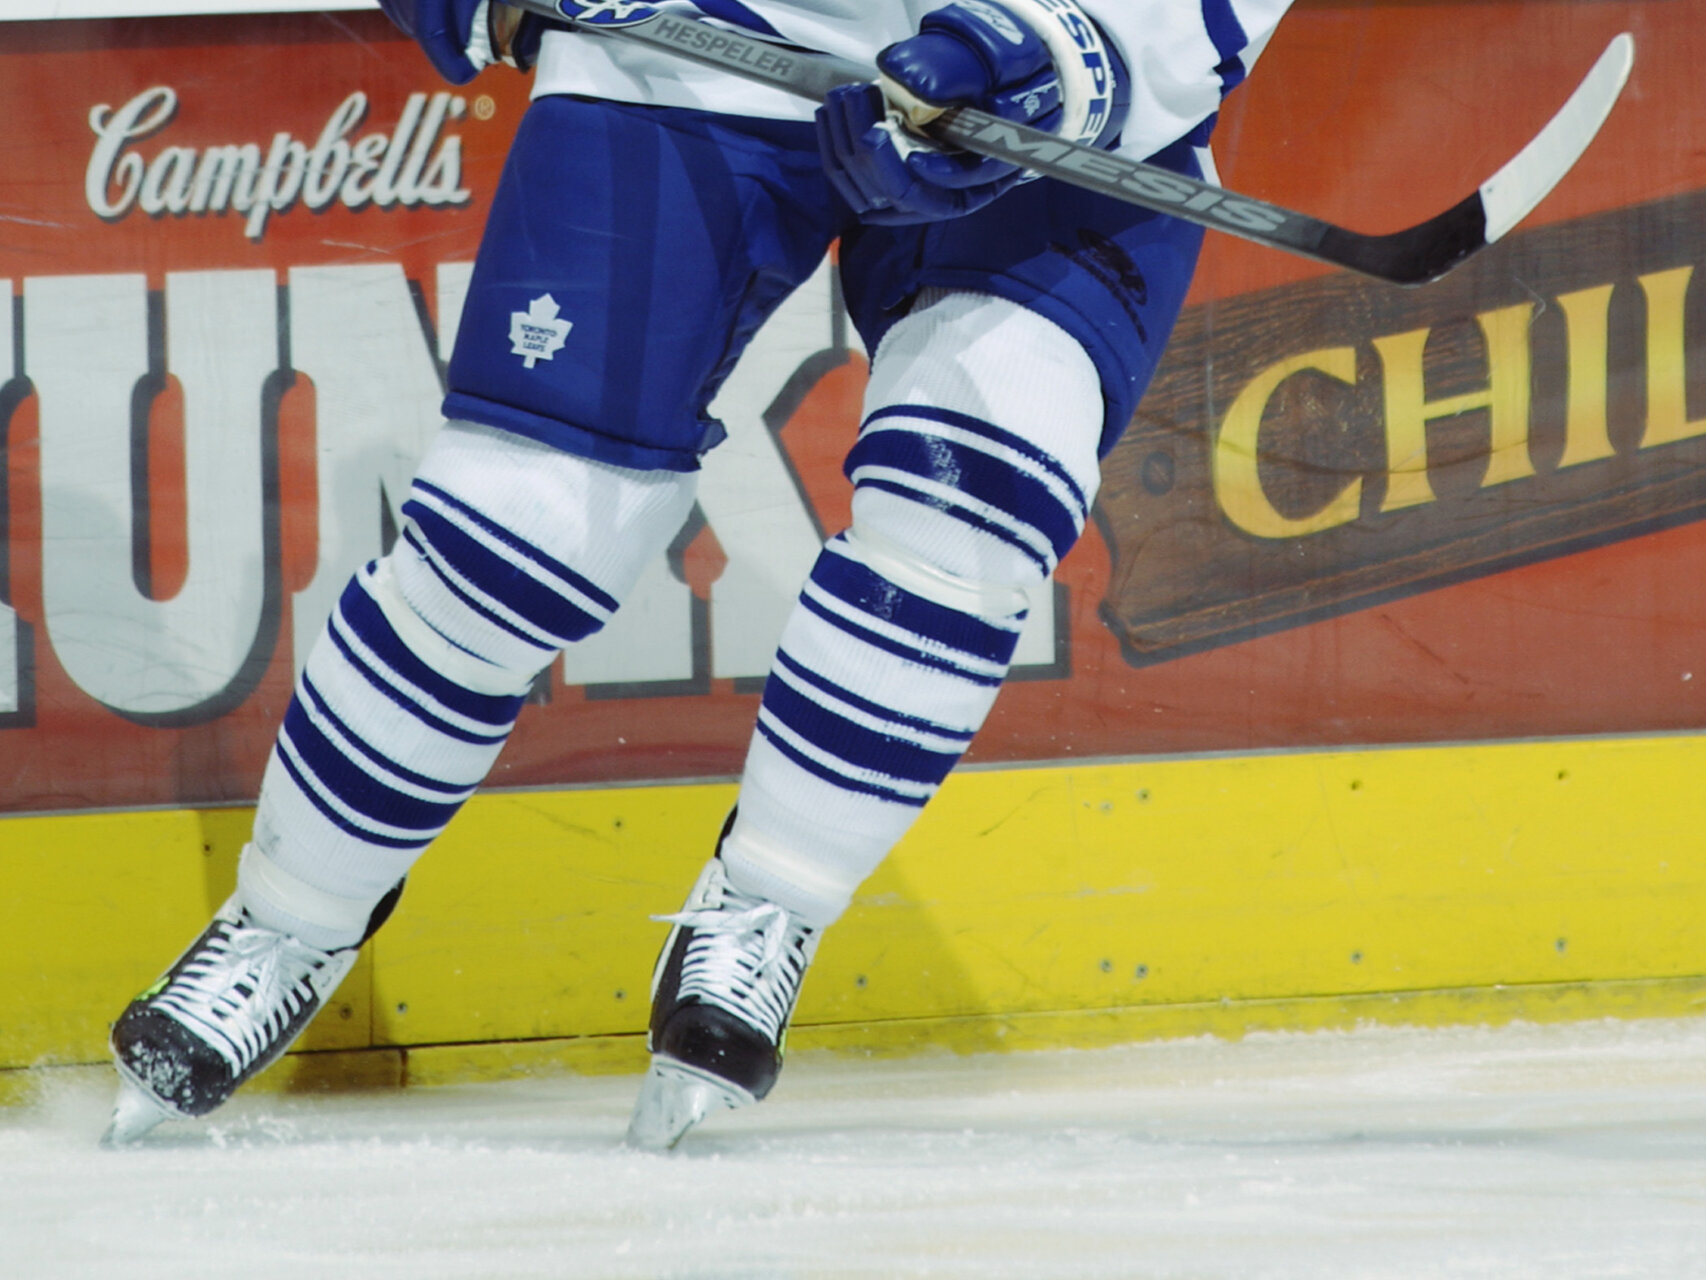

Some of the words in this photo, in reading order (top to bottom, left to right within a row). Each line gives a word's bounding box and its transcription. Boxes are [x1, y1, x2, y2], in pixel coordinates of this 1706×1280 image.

[654, 18, 795, 77] HESPELER
[86, 86, 470, 238] Campbell's
[946, 106, 1286, 231] EMESIS
[521, 324, 557, 337] TORONTO
